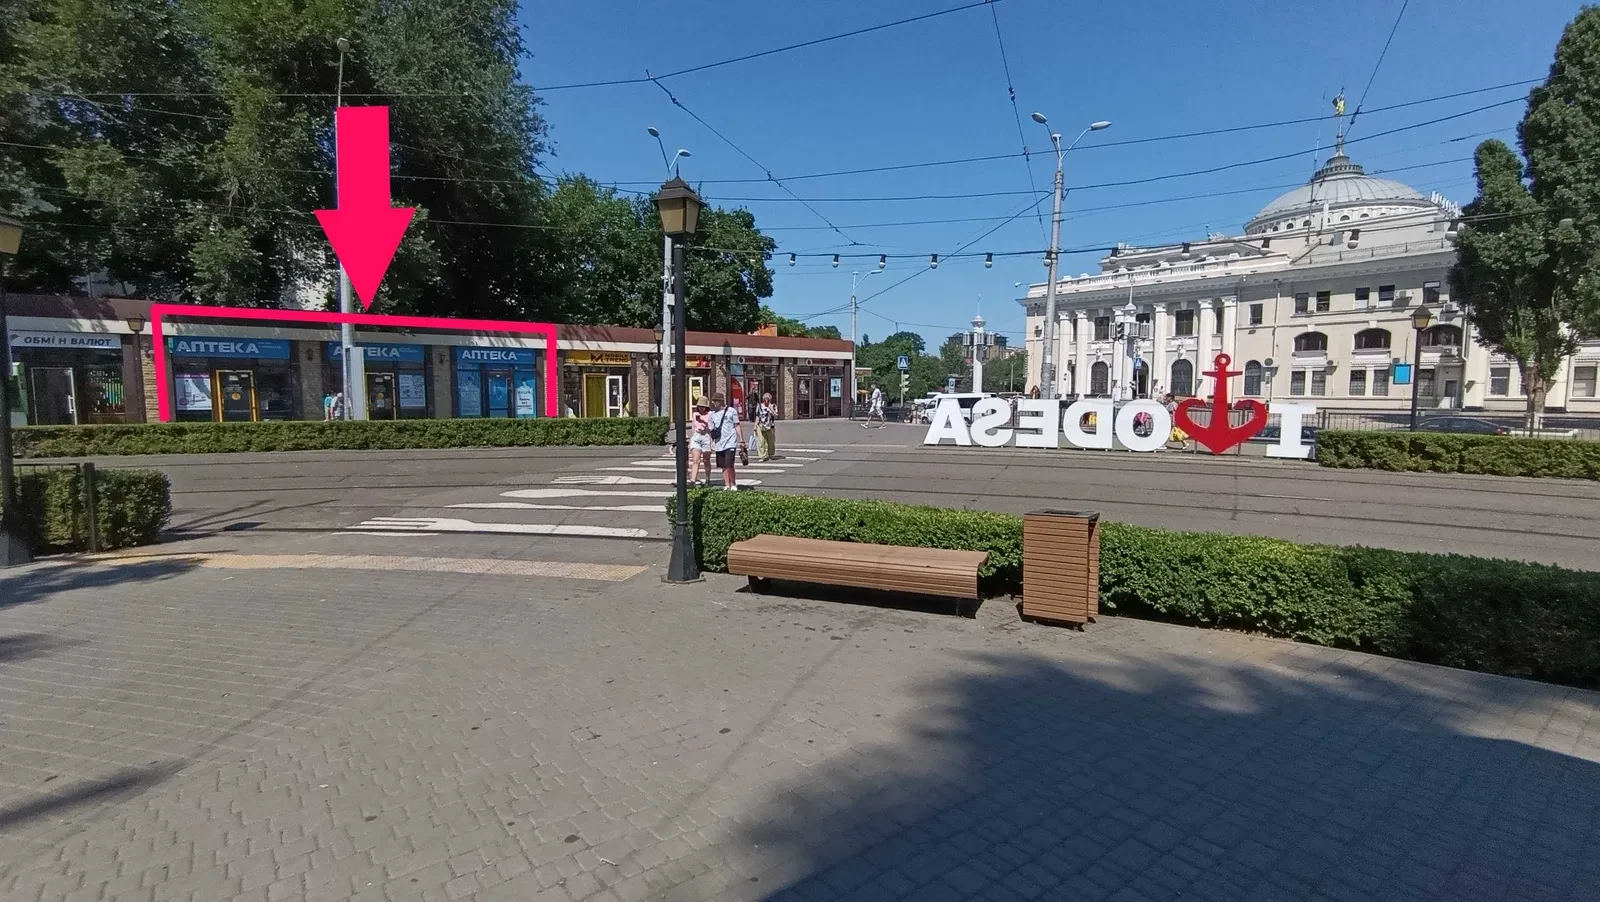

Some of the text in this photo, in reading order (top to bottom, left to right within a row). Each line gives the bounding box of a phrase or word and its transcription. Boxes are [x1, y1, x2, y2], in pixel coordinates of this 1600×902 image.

[71, 338, 112, 346] ВАЛЮТ
[176, 340, 259, 353] АПТЕКА
[333, 346, 400, 357] АЕКА
[462, 350, 518, 360] АПТЕКА
